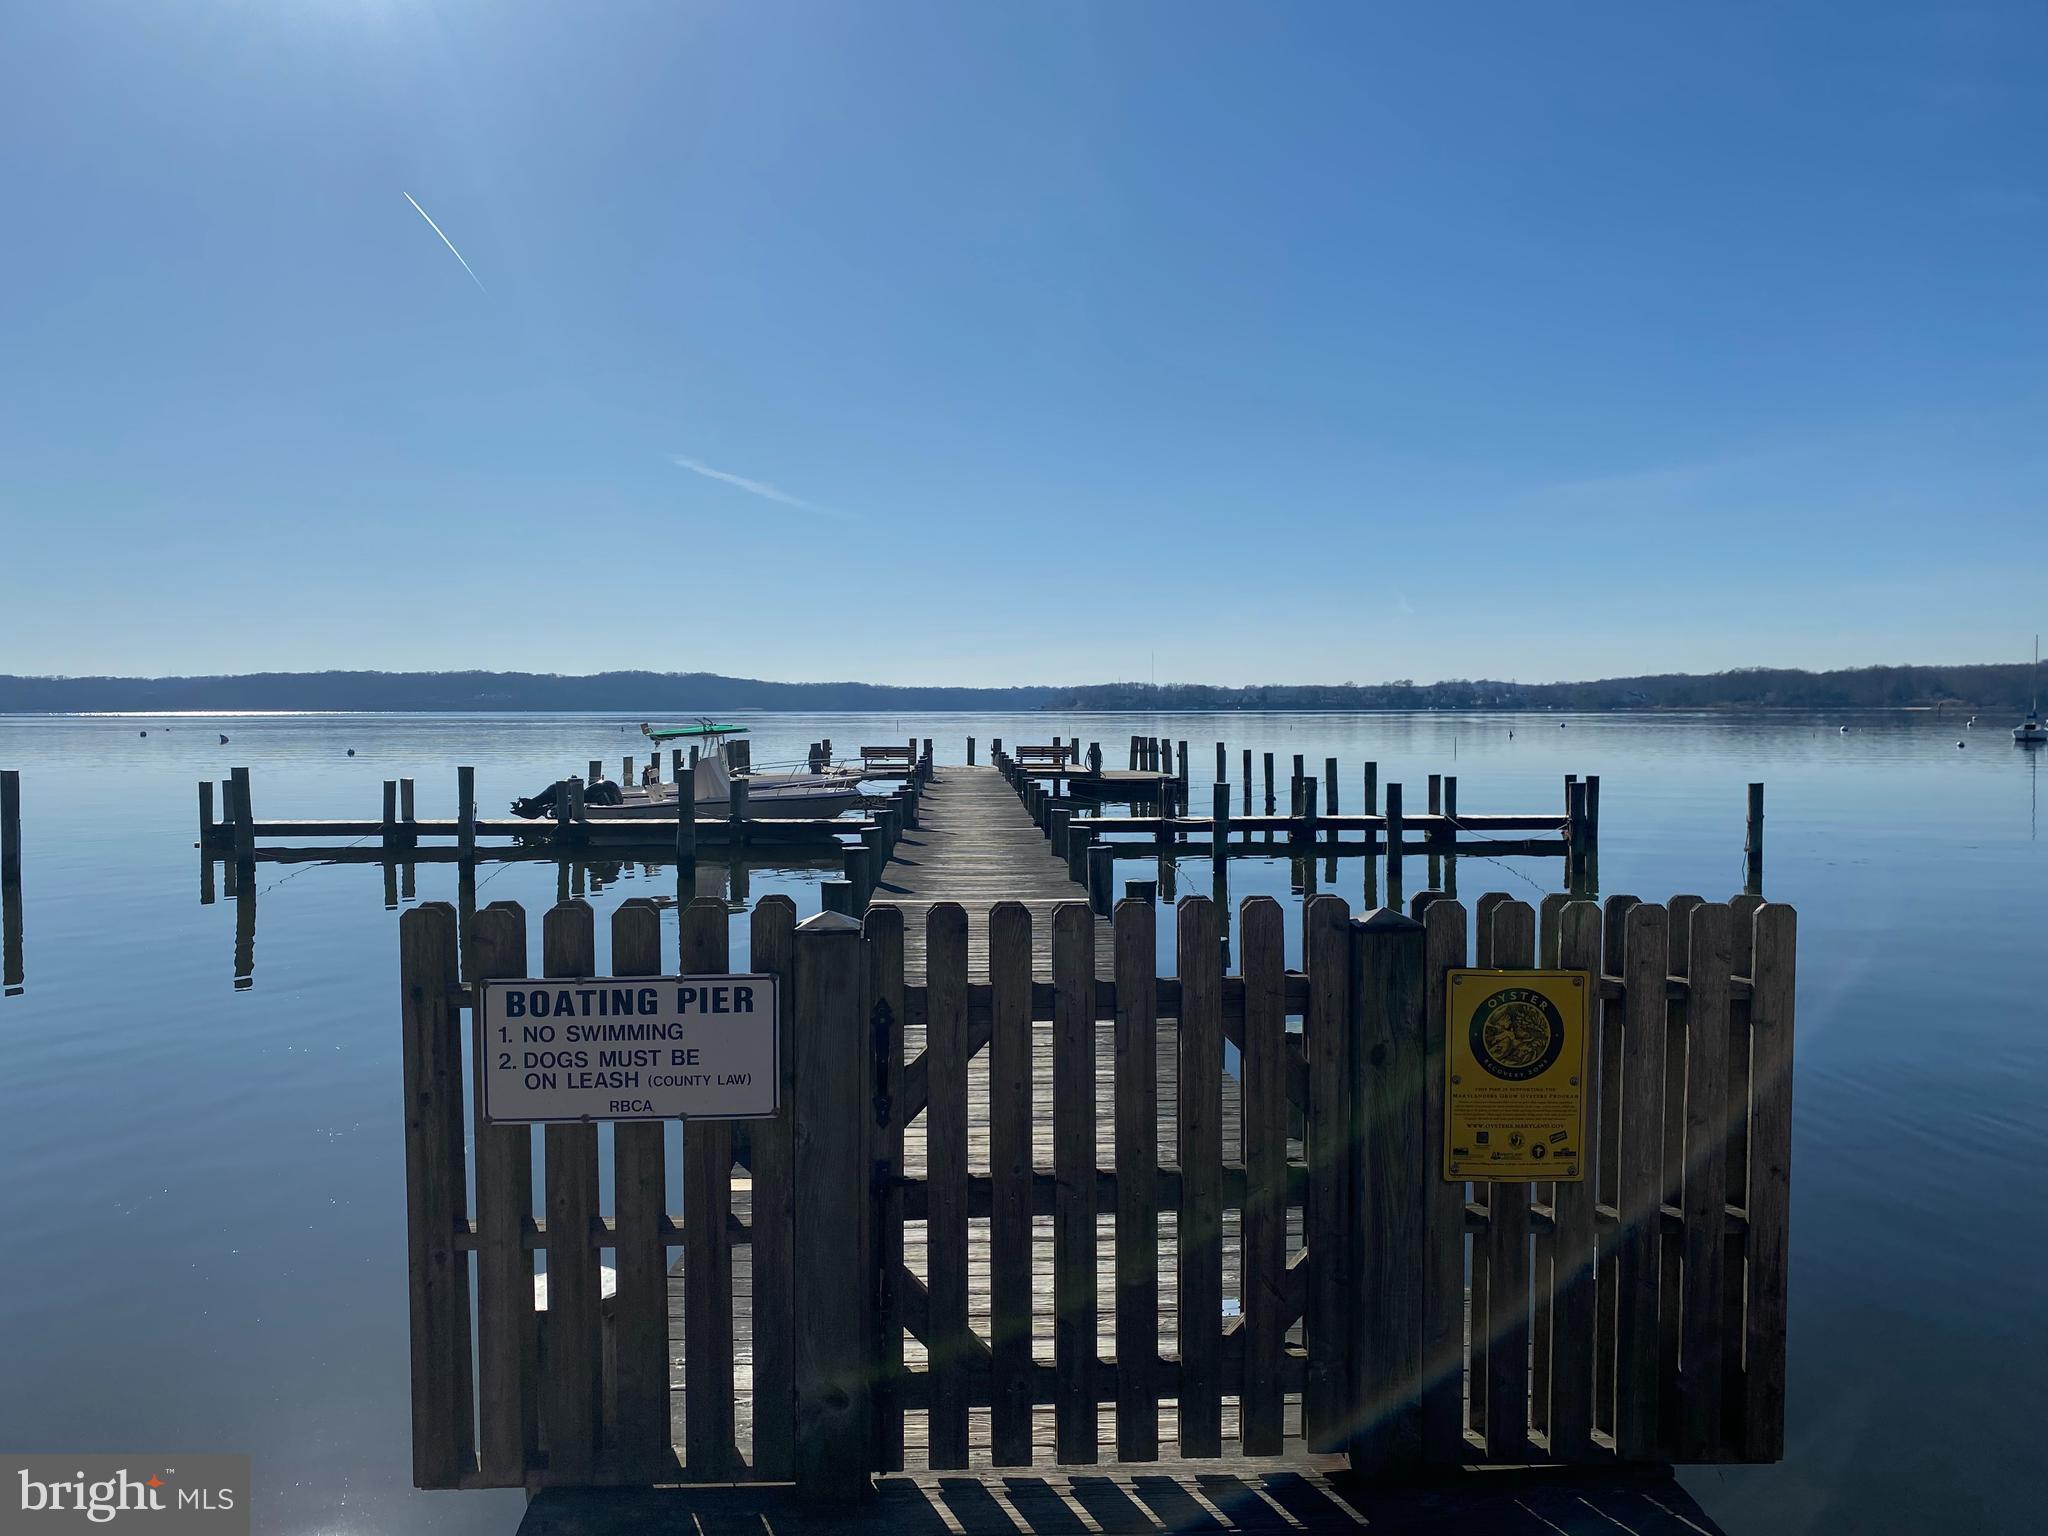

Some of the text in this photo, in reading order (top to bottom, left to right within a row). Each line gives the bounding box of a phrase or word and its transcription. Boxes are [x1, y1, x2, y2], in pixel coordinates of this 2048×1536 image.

[506, 986, 754, 1017] BOATING PIER
[1488, 991, 1549, 1011] OYSTER
[498, 1023, 683, 1043] 1. NO SWIMMING
[499, 1049, 700, 1070] 2. DOGS MUST BE
[524, 1071, 752, 1090] ON LEASH (COUNTY LAW)
[609, 1100, 653, 1112] RBCA
